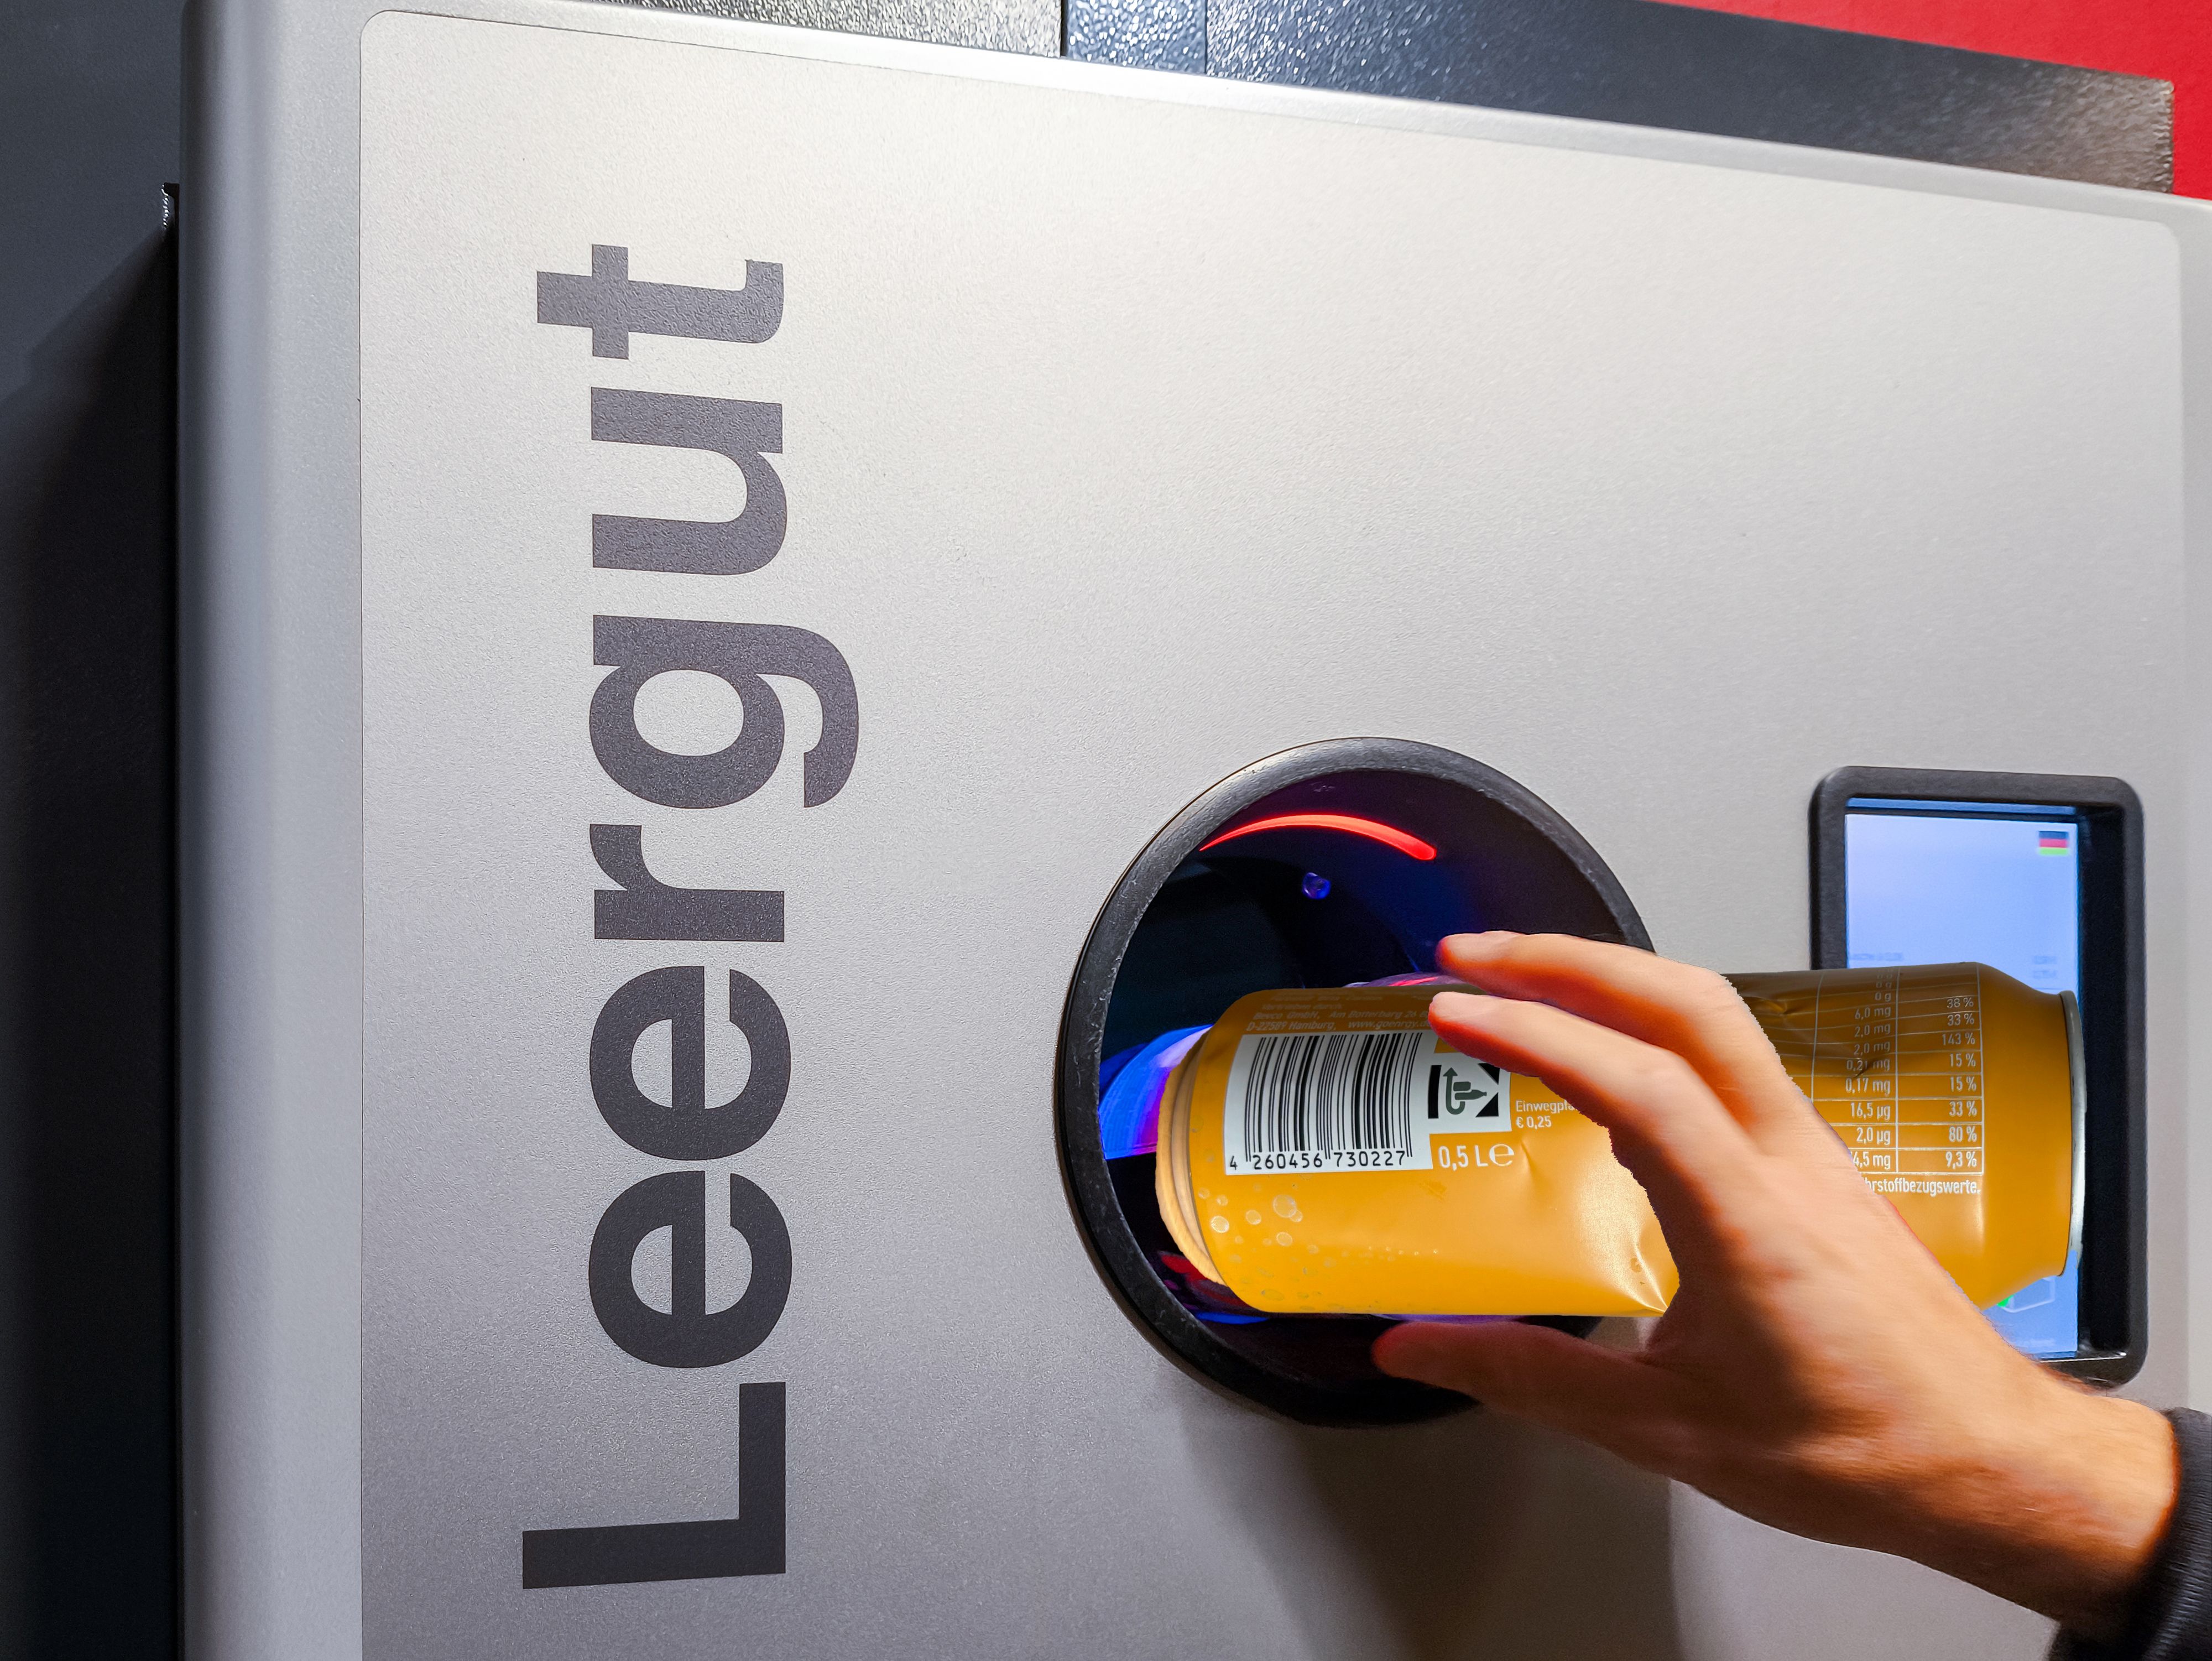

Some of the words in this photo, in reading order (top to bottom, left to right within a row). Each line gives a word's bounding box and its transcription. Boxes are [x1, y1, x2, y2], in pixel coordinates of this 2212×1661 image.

[523, 244, 859, 1589] Leergut
[1875, 992, 1881, 1001] 0
[1884, 993, 1891, 1002] g
[1287, 1011, 1320, 1019] GmbH,
[1854, 1007, 1870, 1020] 6,0
[1874, 1006, 1891, 1017] mg
[1947, 997, 1960, 1008] 38
[1963, 997, 1974, 1007] %
[1288, 1021, 1336, 1031] Hamburg,
[1854, 1024, 1870, 1038] 2,0
[1874, 1024, 1891, 1034] mg
[1947, 1014, 1961, 1026] 33
[1964, 1013, 1975, 1025] %
[1854, 1043, 1870, 1056] 2,0
[1874, 1042, 1891, 1053] mg
[1942, 1033, 1961, 1046] 143
[1965, 1032, 1975, 1045] %
[1872, 1059, 1890, 1071] mg
[1949, 1053, 1963, 1068] 15
[1965, 1053, 1976, 1067] %
[1845, 1077, 1869, 1094] 0,17
[1872, 1080, 1891, 1096] mg
[1950, 1076, 1963, 1092] 15
[1966, 1076, 1977, 1091] %
[1516, 1100, 1578, 1113] Einwegpfa
[1850, 1102, 1874, 1118] 16,5
[1949, 1101, 1963, 1117] 33
[1966, 1101, 1977, 1116] %
[1516, 1117, 1524, 1128] €
[1526, 1116, 1552, 1129] 0,25
[1856, 1127, 1874, 1144] 2,0
[1948, 1126, 1963, 1142] 80
[1966, 1126, 1977, 1142] %
[1229, 1155, 1238, 1170] 4
[1253, 1153, 1323, 1170] 260456
[1333, 1150, 1406, 1168] 730227
[1438, 1145, 1469, 1171] 0,5
[1851, 1151, 1870, 1168] 4,5
[1872, 1155, 1891, 1170] mg
[1945, 1151, 1963, 1169] 9,3
[1966, 1151, 1977, 1168] %
[1864, 1177, 1981, 1197] hrstoffbezugswerte.
